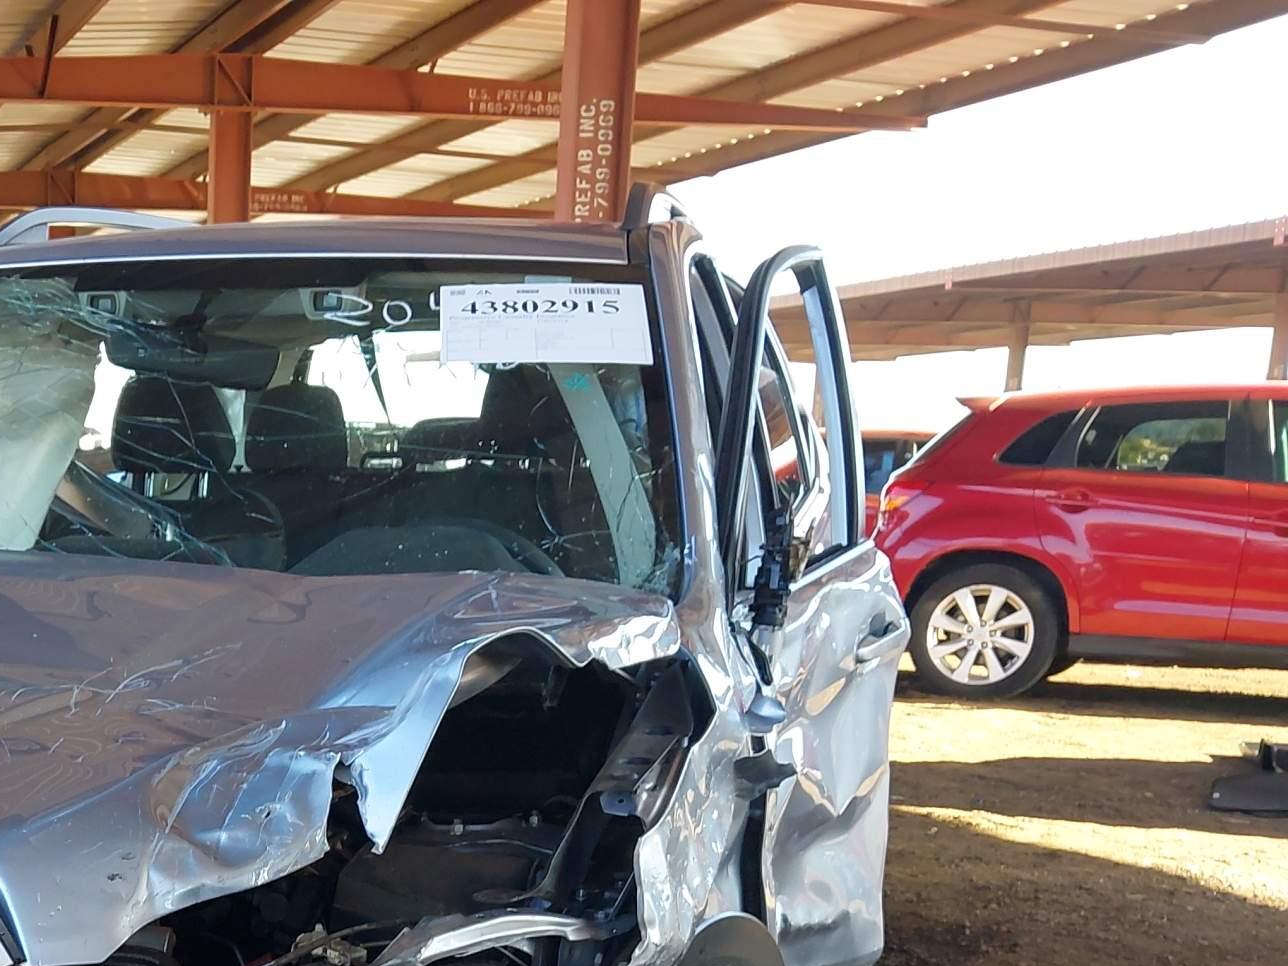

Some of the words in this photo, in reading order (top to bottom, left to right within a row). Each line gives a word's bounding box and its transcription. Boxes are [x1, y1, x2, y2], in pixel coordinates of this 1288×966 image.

[468, 88, 491, 100] U.S.
[497, 89, 543, 103] PREFAB
[579, 98, 596, 138] INC.
[462, 299, 620, 315] 43802915
